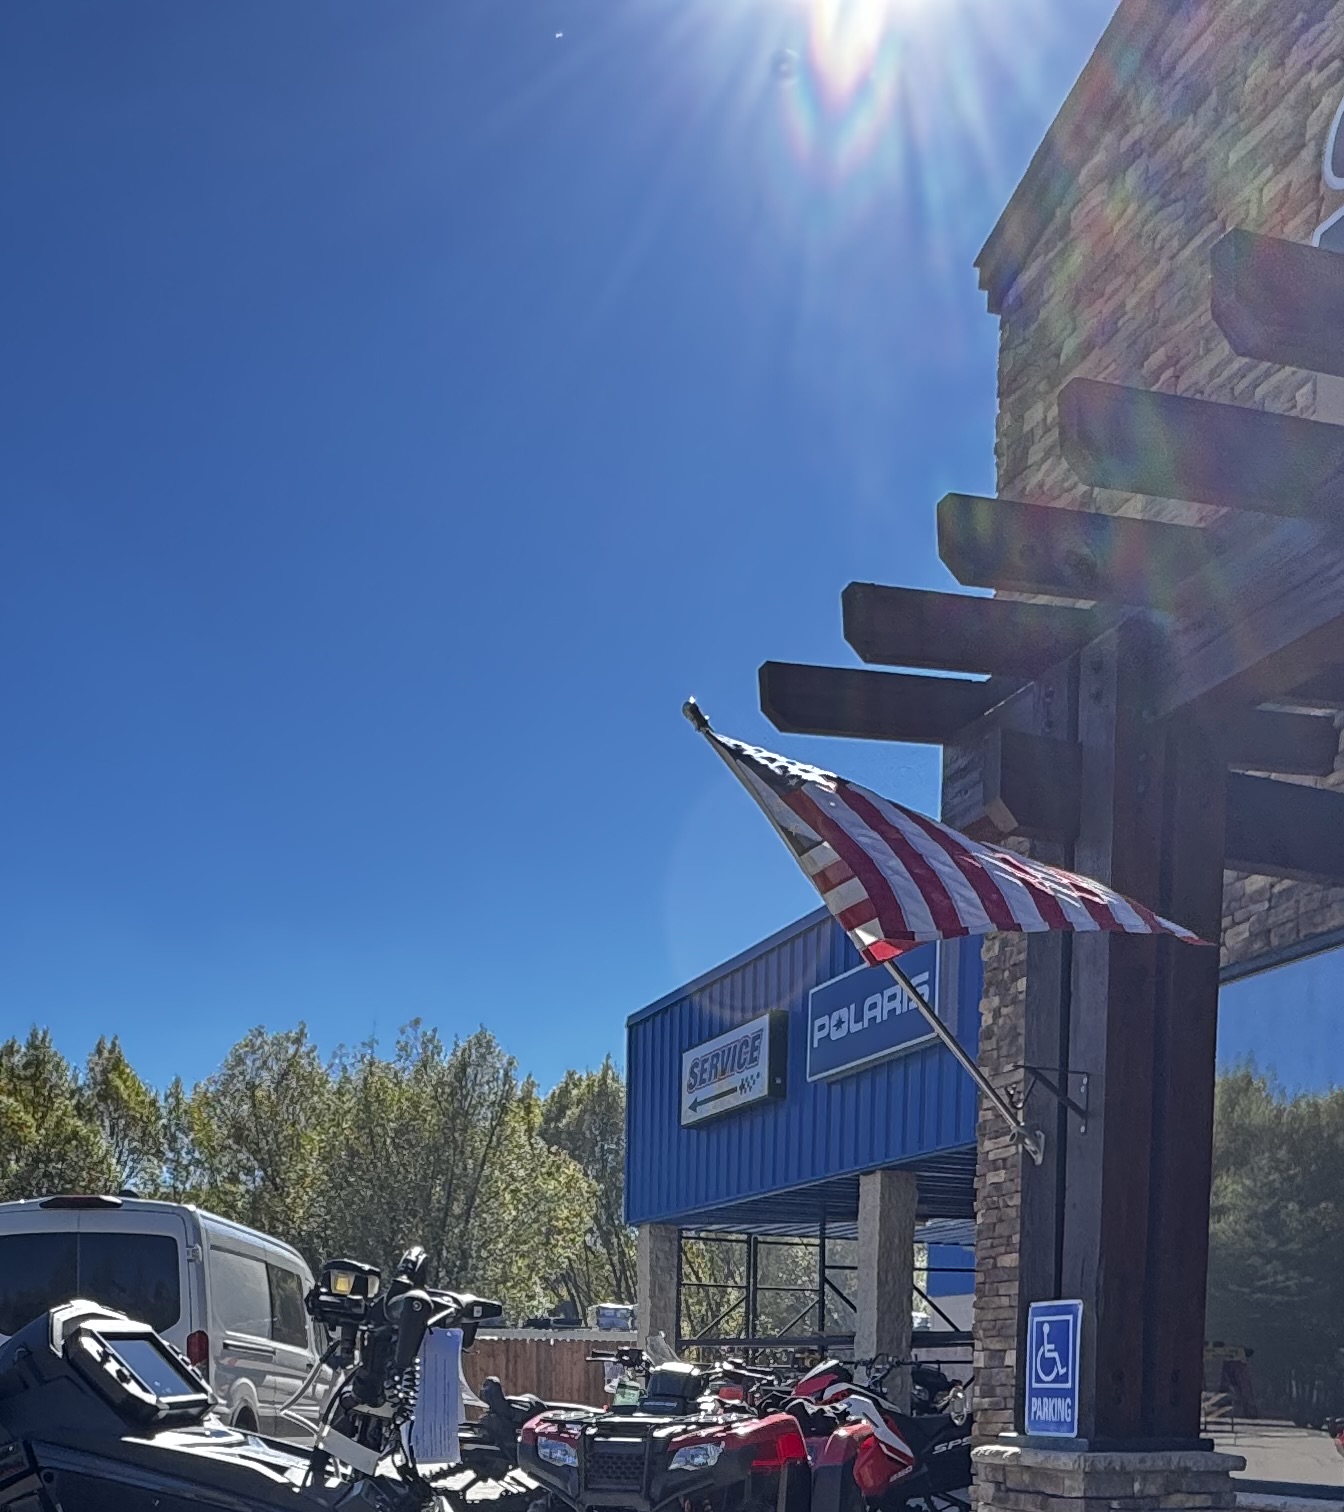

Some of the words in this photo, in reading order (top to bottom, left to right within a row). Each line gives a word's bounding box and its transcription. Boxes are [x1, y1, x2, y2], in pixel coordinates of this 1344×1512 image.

[813, 971, 930, 1048] POLARIS
[686, 1027, 764, 1094] SERVICE
[1031, 1397, 1072, 1423] PARKING
